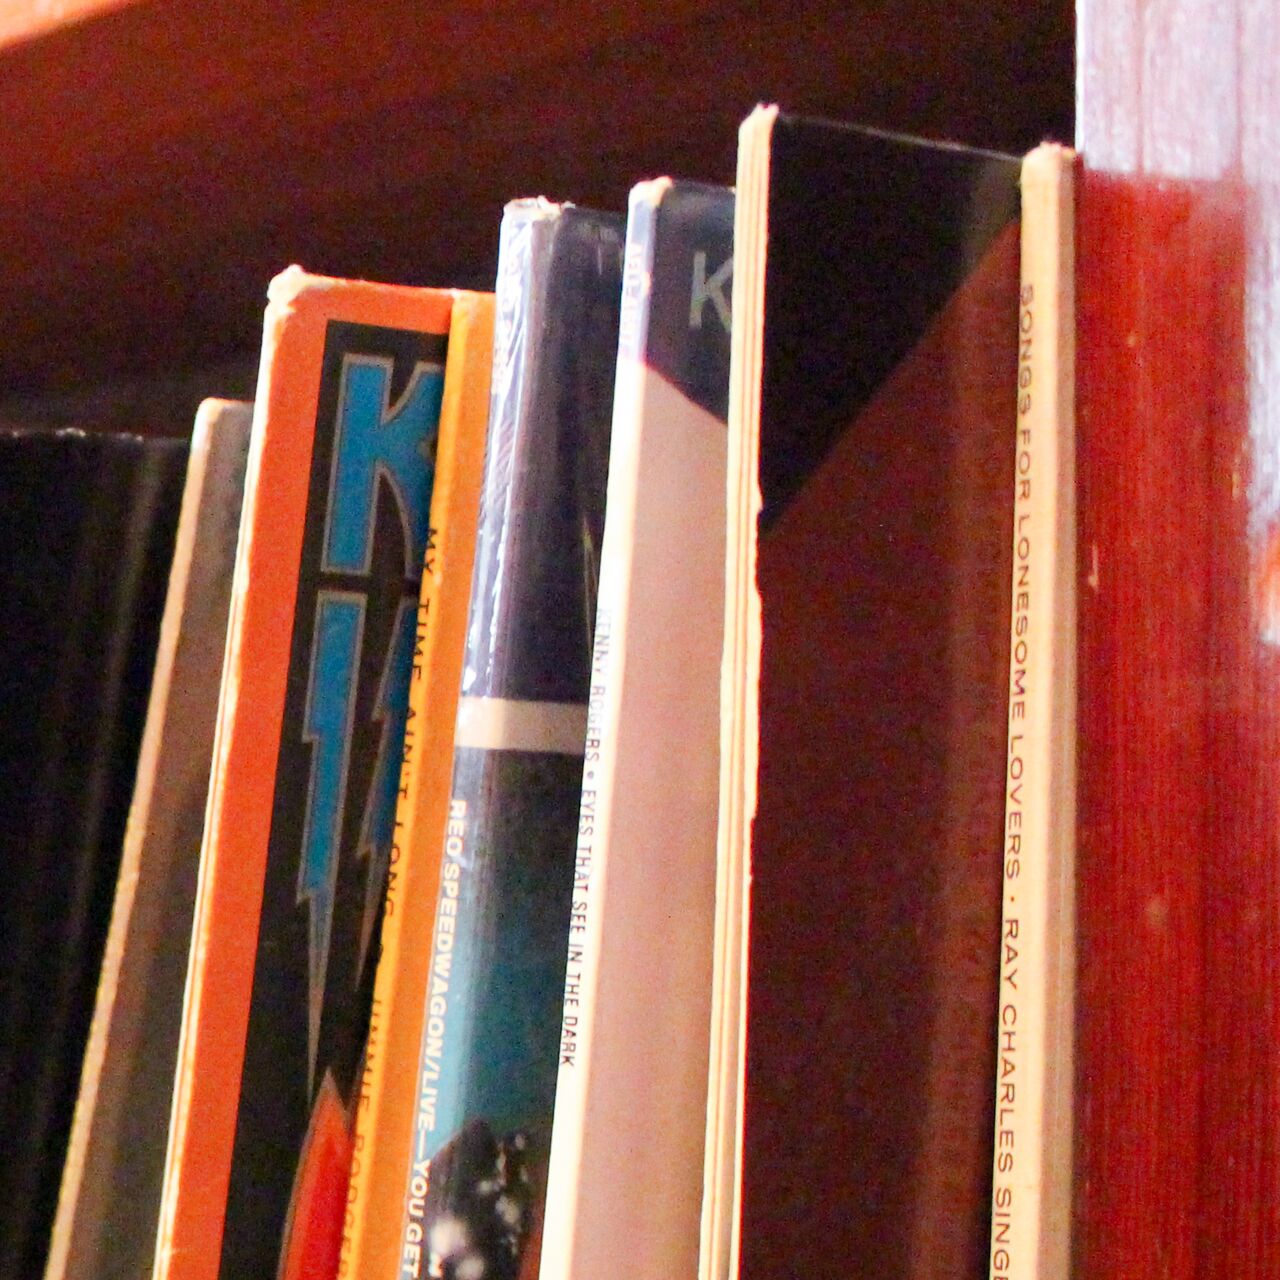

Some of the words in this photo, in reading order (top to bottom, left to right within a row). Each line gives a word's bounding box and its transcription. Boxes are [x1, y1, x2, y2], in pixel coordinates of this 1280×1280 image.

[1019, 284, 1033, 416] SONGS
[1018, 429, 1031, 500] FOR
[421, 528, 437, 574] MY
[594, 610, 611, 673] KENNY
[1012, 514, 1030, 720] LONESOME
[399, 706, 416, 799] AIN'T
[585, 685, 606, 763] ROGERS
[446, 799, 467, 857] REO
[579, 790, 597, 836] EYES
[1006, 735, 1024, 881] LOVERS
[574, 845, 592, 891] THAT
[570, 901, 588, 934] SEE
[568, 944, 584, 964] IN
[1002, 919, 1020, 990] RAY
[565, 973, 581, 1007] THE
[560, 1016, 578, 1067] DARK
[996, 1004, 1018, 1174] CHARLES
[403, 1222, 423, 1279] GET
